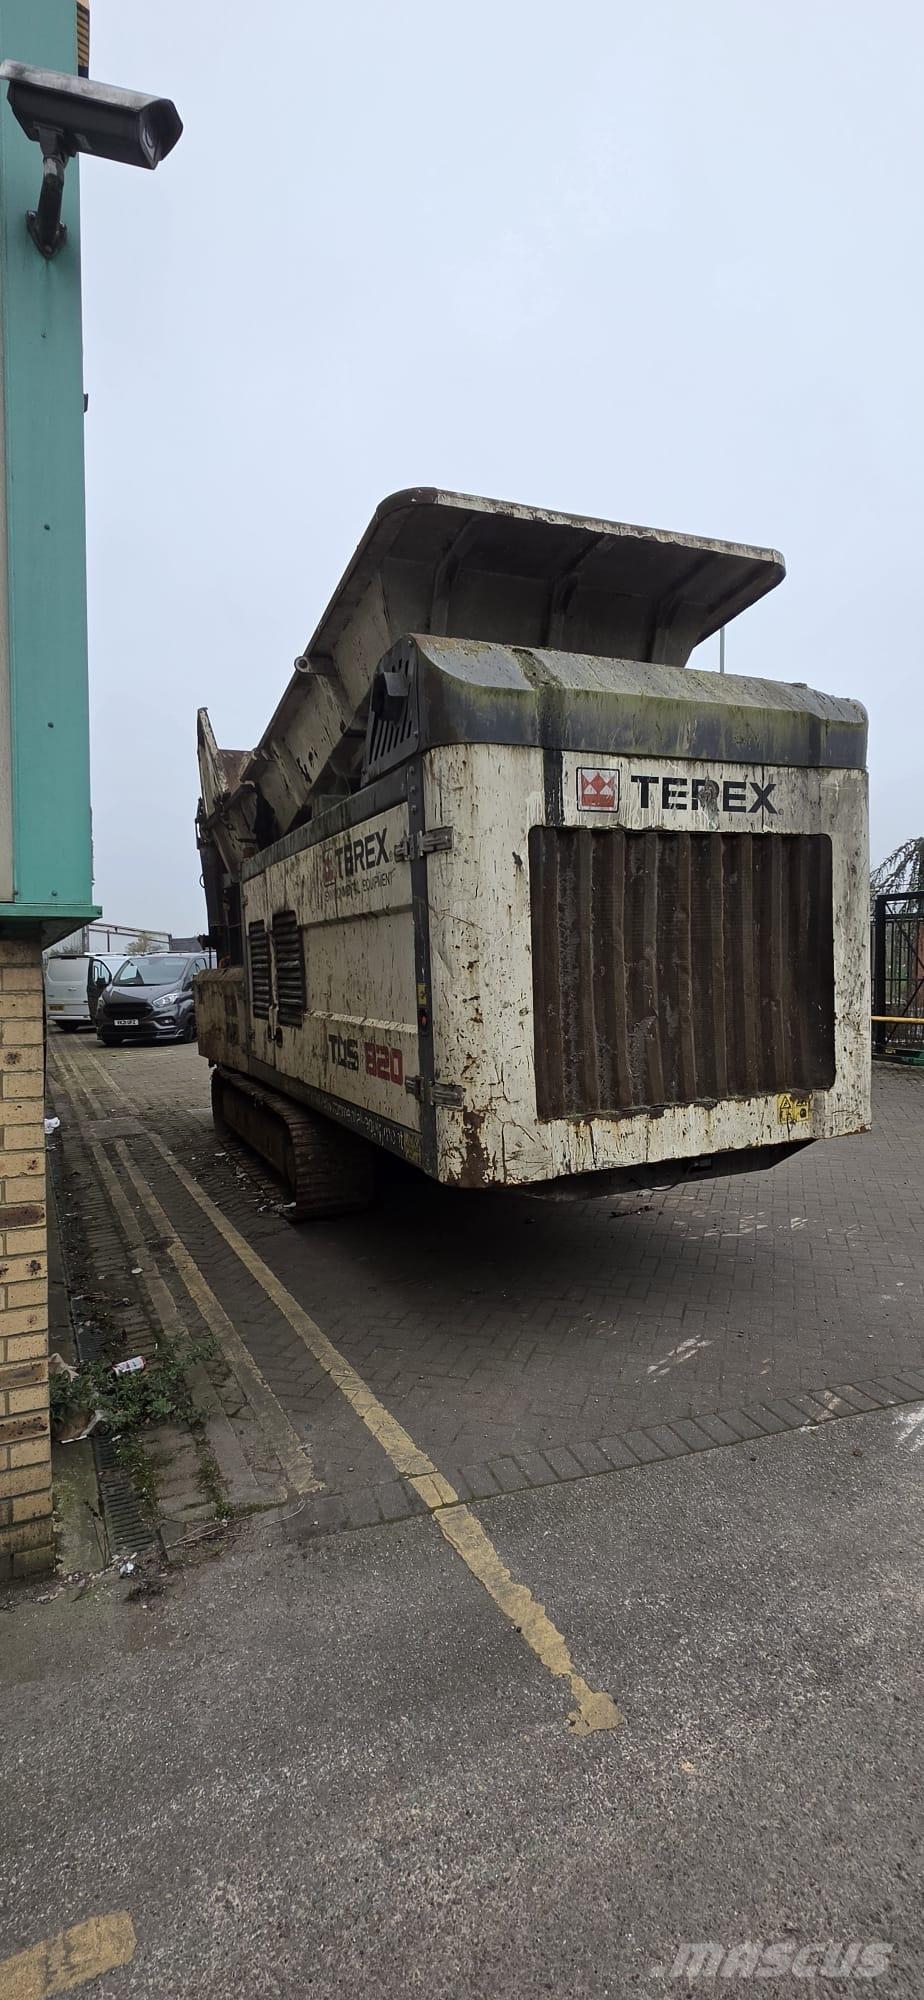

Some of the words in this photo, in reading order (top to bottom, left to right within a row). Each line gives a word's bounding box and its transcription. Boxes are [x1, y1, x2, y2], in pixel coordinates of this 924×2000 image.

[630, 774, 778, 814] TEREX
[335, 826, 390, 880] TEREX
[328, 1034, 359, 1072] TDS
